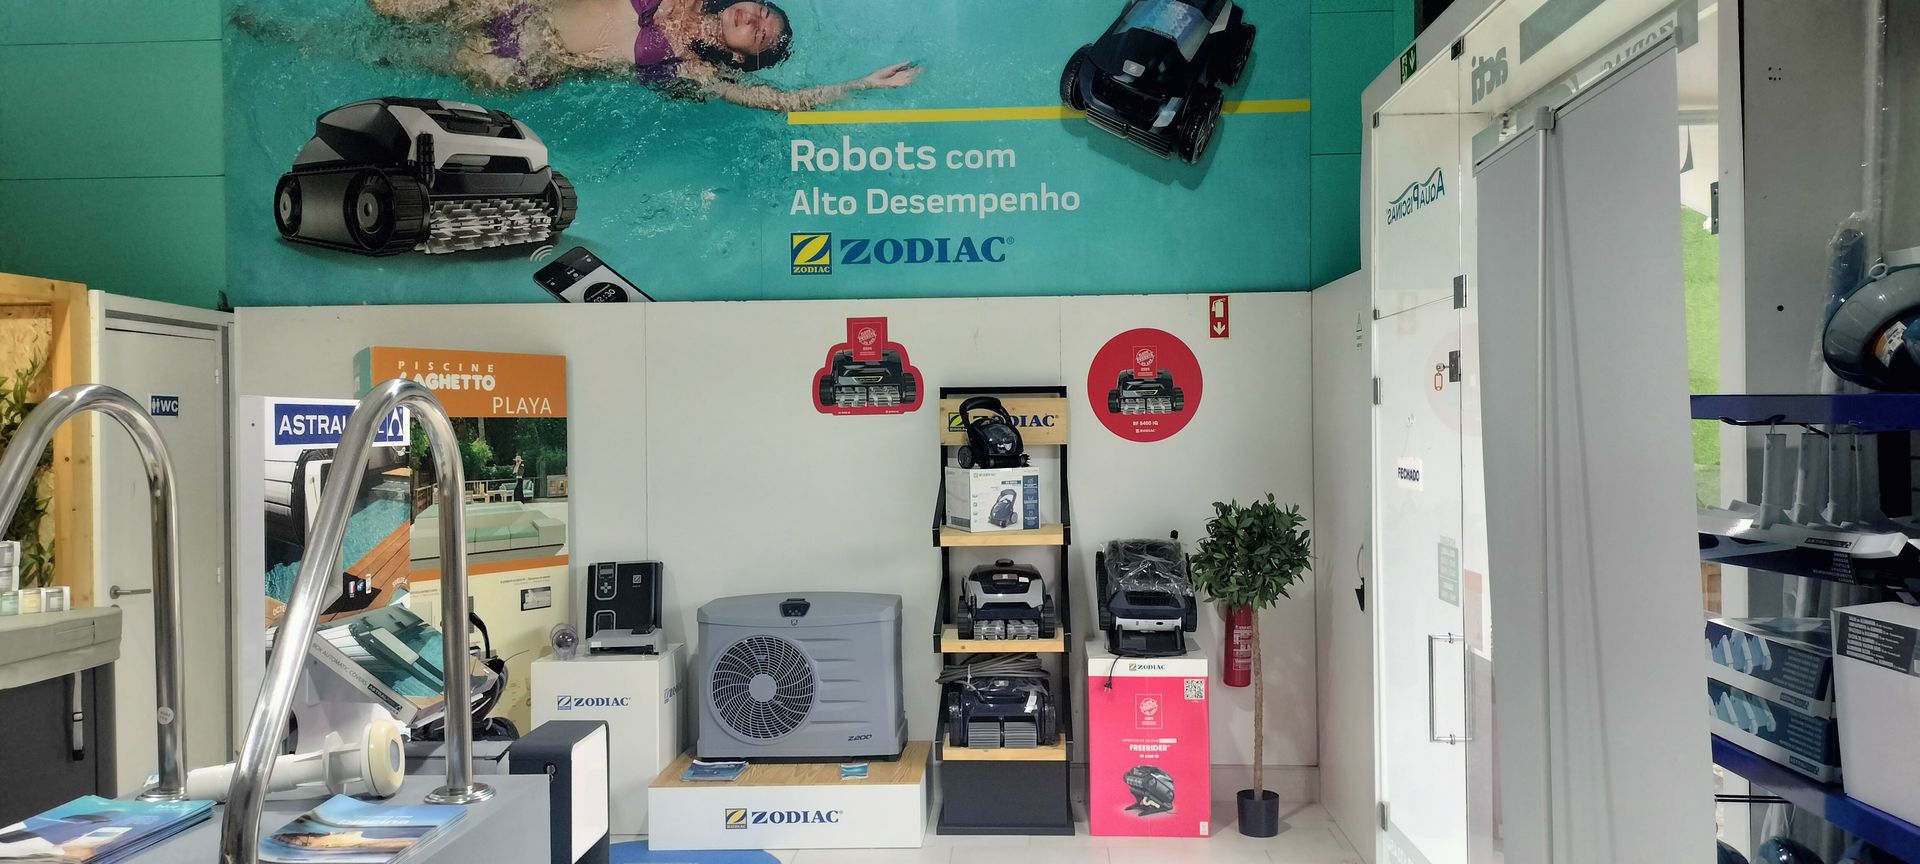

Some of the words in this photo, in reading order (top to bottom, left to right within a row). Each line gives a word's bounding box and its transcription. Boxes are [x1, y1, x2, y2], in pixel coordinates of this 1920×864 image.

[790, 136, 936, 172] Robots
[946, 148, 1016, 169] com
[790, 187, 857, 215] Alto
[867, 182, 1080, 219] Desempenho
[398, 361, 494, 373] PISCINE
[400, 372, 496, 391] AGHETTO
[160, 400, 178, 412] WC
[492, 397, 552, 414] PLAYA
[574, 697, 629, 707] ZODIAC
[752, 810, 839, 824] ZODIAC
